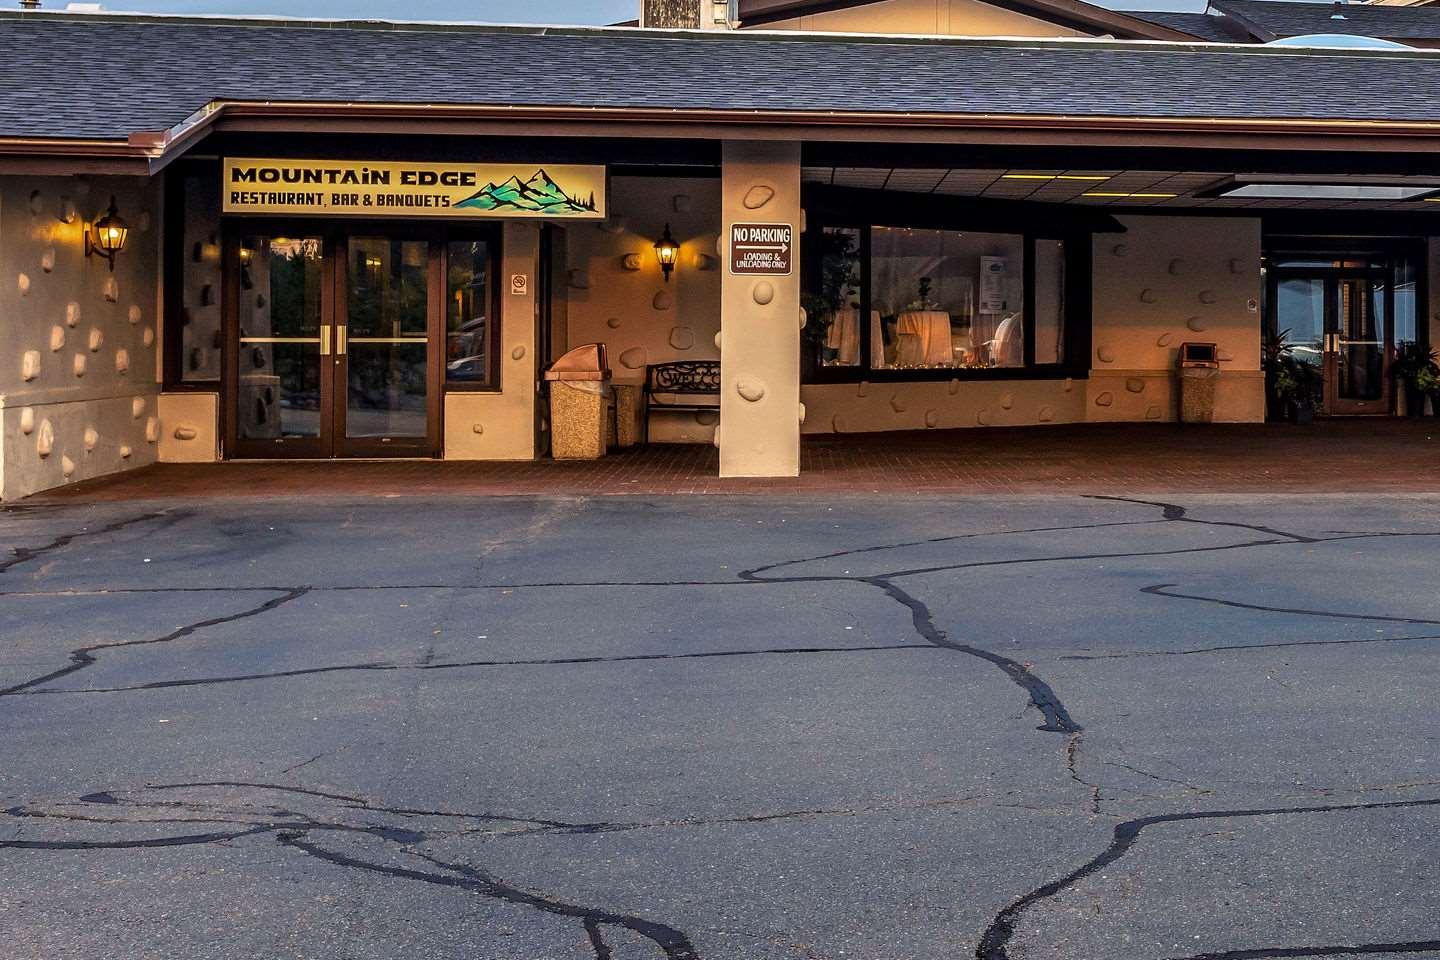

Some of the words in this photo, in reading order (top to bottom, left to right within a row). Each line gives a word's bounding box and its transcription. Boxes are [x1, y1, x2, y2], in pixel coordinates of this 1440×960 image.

[399, 171, 476, 186] EDGE
[230, 191, 327, 208] RESTAURANT,
[331, 193, 359, 207] BAR
[362, 194, 373, 207] &
[376, 194, 450, 208] BANQUETS
[733, 228, 748, 241] NO
[750, 228, 790, 242] PARKING
[736, 260, 771, 268] UNLOADING
[774, 253, 781, 261] &
